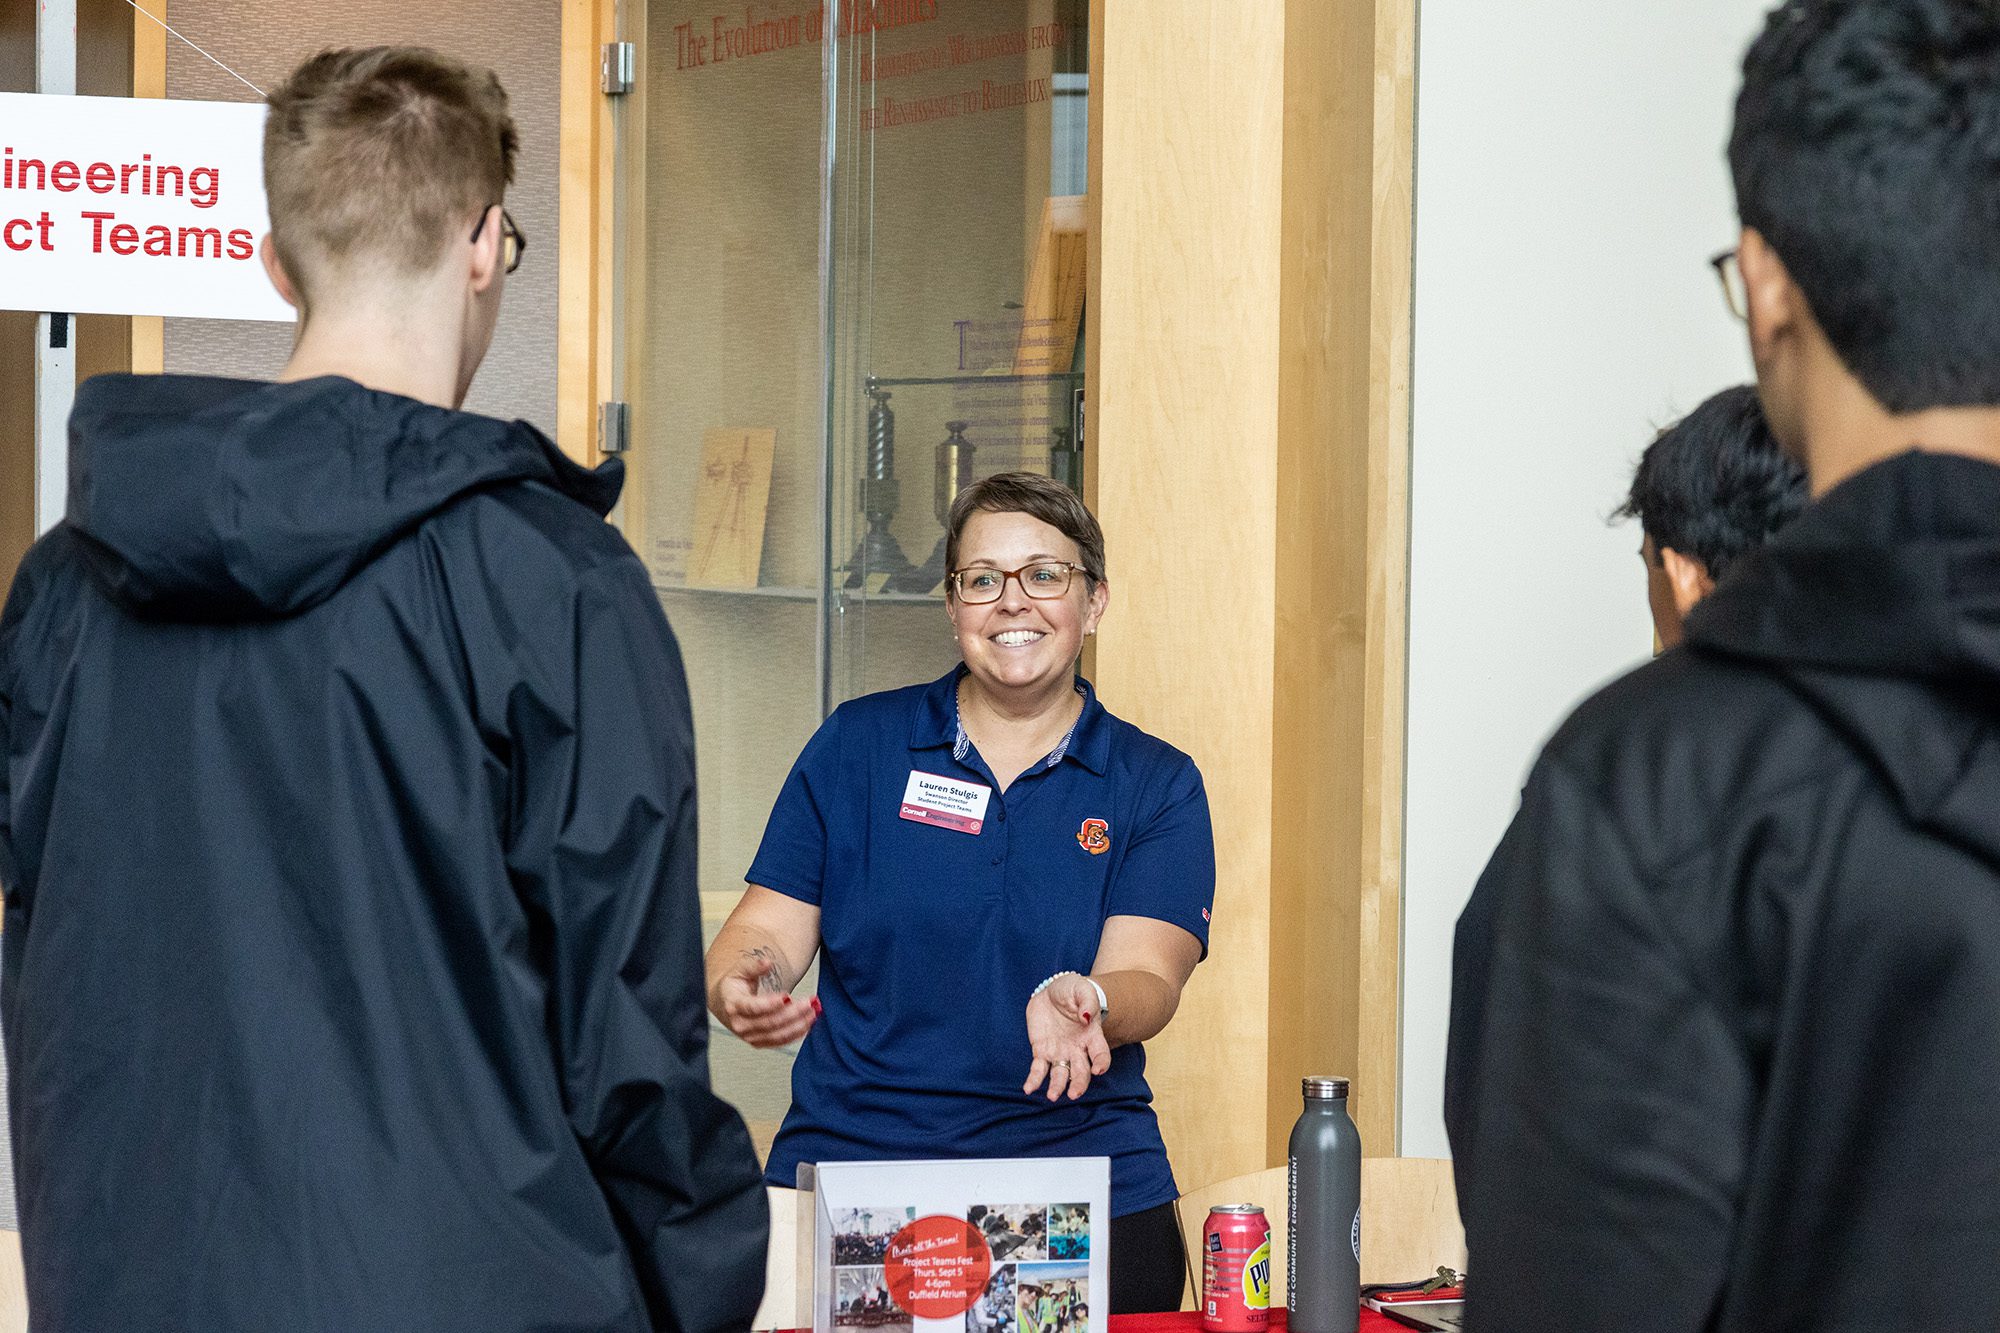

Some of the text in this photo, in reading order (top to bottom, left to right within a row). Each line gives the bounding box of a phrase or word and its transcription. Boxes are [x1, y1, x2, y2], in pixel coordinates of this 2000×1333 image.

[674, 21, 707, 70] The
[712, 7, 800, 63] Evolution
[3, 147, 220, 208] ineering
[3, 211, 254, 260] ct Teams
[919, 780, 978, 800] Lauren Stulgis
[917, 796, 972, 813] Student Project Teams
[925, 791, 969, 805] Swanson Director
[902, 806, 927, 818] Cornell
[903, 1256, 973, 1267] Project Teams Fest
[1290, 1226, 1298, 1290] COMMUNITY
[938, 1268, 956, 1277] Sept
[957, 1267, 963, 1276] 5
[925, 1279, 951, 1288] 4-6pm
[908, 1289, 967, 1300] Duffield Atrium
